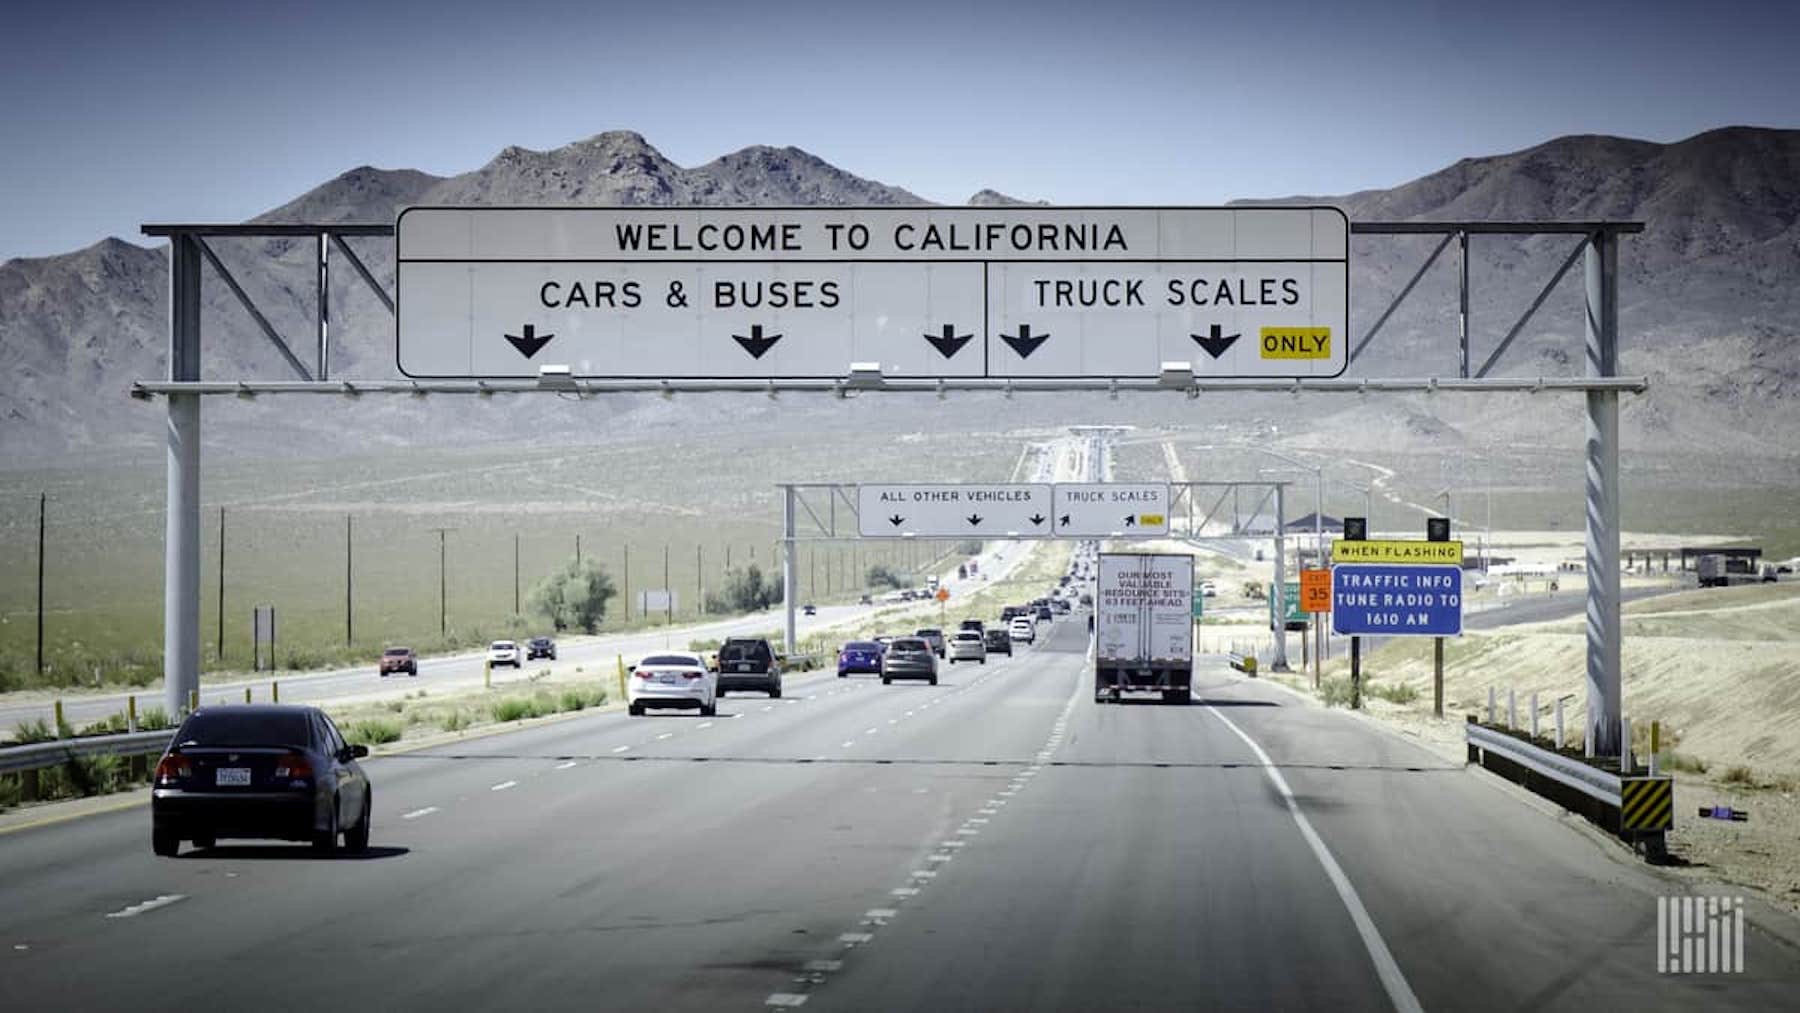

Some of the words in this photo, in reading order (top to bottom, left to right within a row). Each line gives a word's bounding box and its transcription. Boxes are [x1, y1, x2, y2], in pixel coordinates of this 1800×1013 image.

[616, 224, 802, 251] WELCOME
[825, 224, 869, 251] TO
[894, 224, 1128, 251] CALIFORNIA
[540, 281, 642, 308] CARS
[666, 281, 688, 308] &
[715, 281, 840, 308] BUSES
[1033, 279, 1145, 307] TRUCK
[1167, 278, 1299, 306] SCALES
[1262, 334, 1329, 354] ONLY
[880, 491, 906, 502] ALL
[913, 490, 959, 502] OTHER
[967, 490, 1032, 502] VEHICLES
[1066, 491, 1105, 502] TRUCK
[1111, 490, 1158, 502] SCALES
[1340, 546, 1379, 557] WHEN
[1384, 547, 1456, 558] FLASHING
[1117, 571, 1140, 579] OUR
[1143, 571, 1172, 580] MOST
[1342, 574, 1409, 588] TRAFFIC
[1416, 574, 1452, 588] INFO
[1119, 580, 1171, 589] VALUABLE
[1105, 589, 1157, 598] RESOURCE
[1308, 587, 1328, 601] 35
[1337, 593, 1378, 607] TUNE
[1383, 593, 1434, 607] RADIO
[1440, 593, 1460, 607] TO
[1119, 598, 1144, 606] FEET
[1366, 612, 1399, 626] 1610
[1406, 613, 1429, 625] AM
